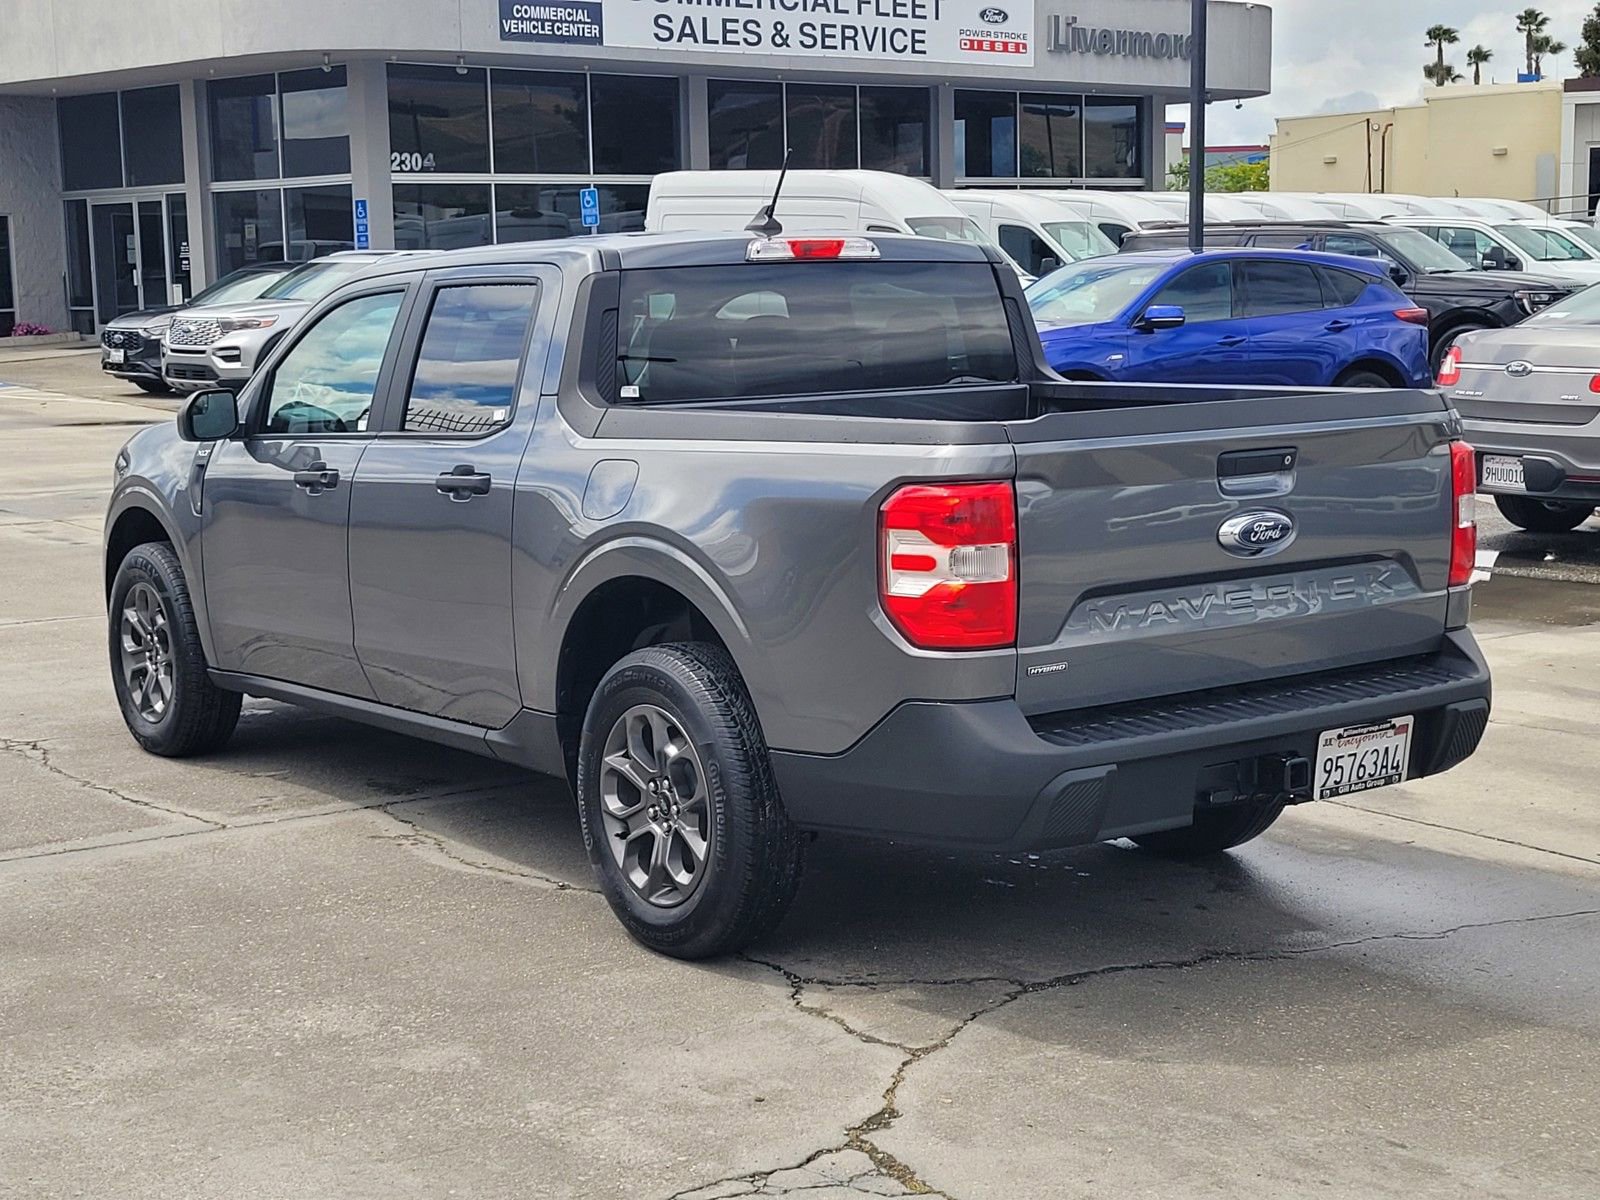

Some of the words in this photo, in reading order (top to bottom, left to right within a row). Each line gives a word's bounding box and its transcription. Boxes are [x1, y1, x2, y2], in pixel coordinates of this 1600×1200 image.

[513, 5, 592, 22] COMMERCIAL
[857, 0, 944, 21] FLEET
[502, 20, 553, 35] VEHICLE
[554, 22, 600, 39] CENTER
[653, 14, 763, 47] SALES
[771, 21, 791, 48] &
[799, 22, 927, 55] SERVICE
[959, 28, 992, 39] POWER
[992, 30, 1028, 41] STROKE
[960, 39, 1028, 53] DIESEL
[391, 152, 436, 172] 2304
[1250, 521, 1283, 542] Ford
[1088, 570, 1396, 634] MAVERICK
[1029, 663, 1067, 675] HYBRID
[1320, 744, 1400, 788] 95763A4
